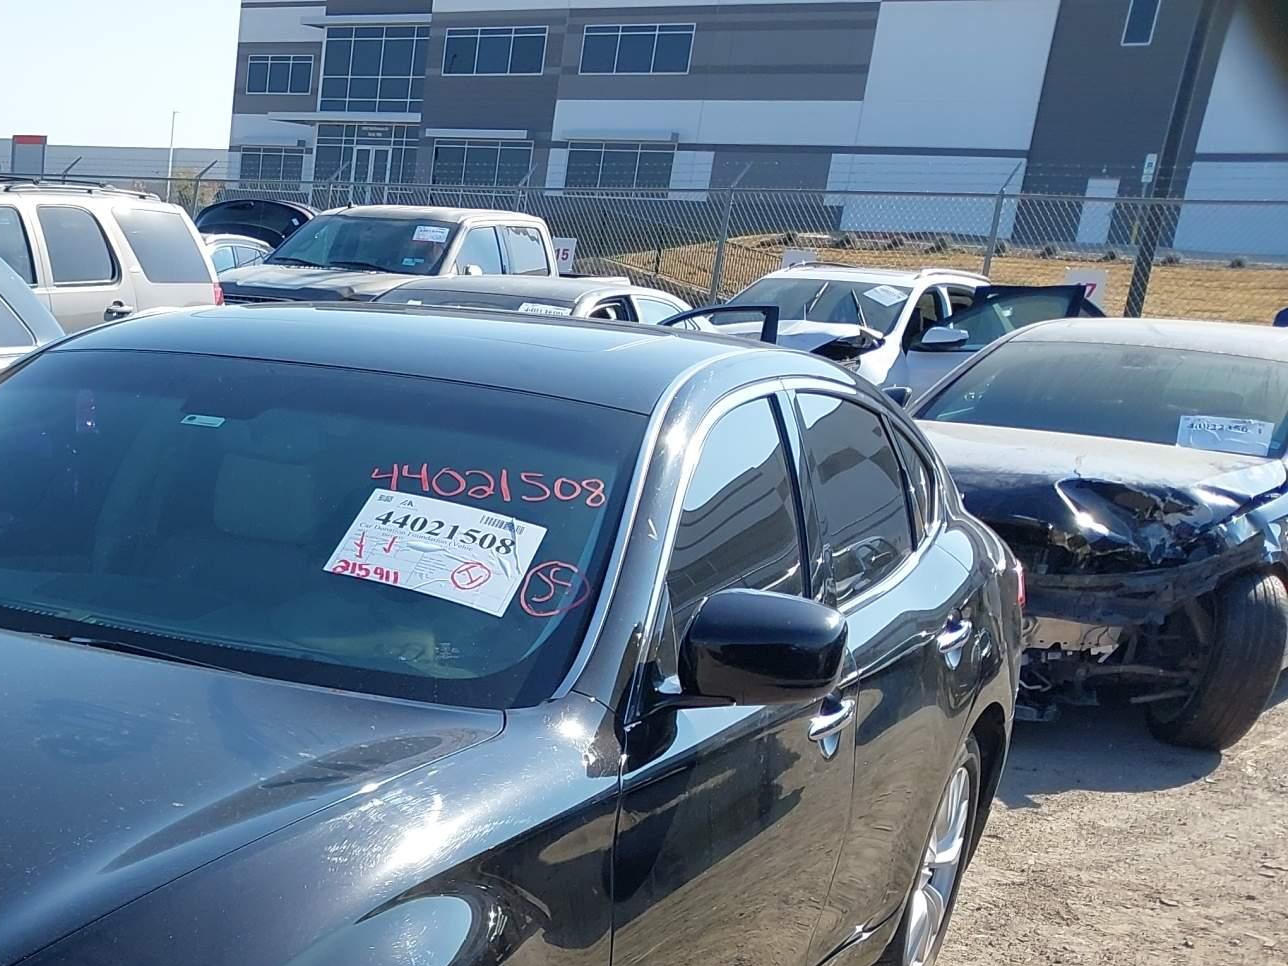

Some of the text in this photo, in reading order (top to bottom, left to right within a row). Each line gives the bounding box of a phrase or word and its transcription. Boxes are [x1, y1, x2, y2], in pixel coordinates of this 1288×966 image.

[556, 247, 569, 261] 15
[1083, 282, 1097, 298] 7
[371, 463, 606, 507] 44021508
[375, 510, 516, 555] 44021508
